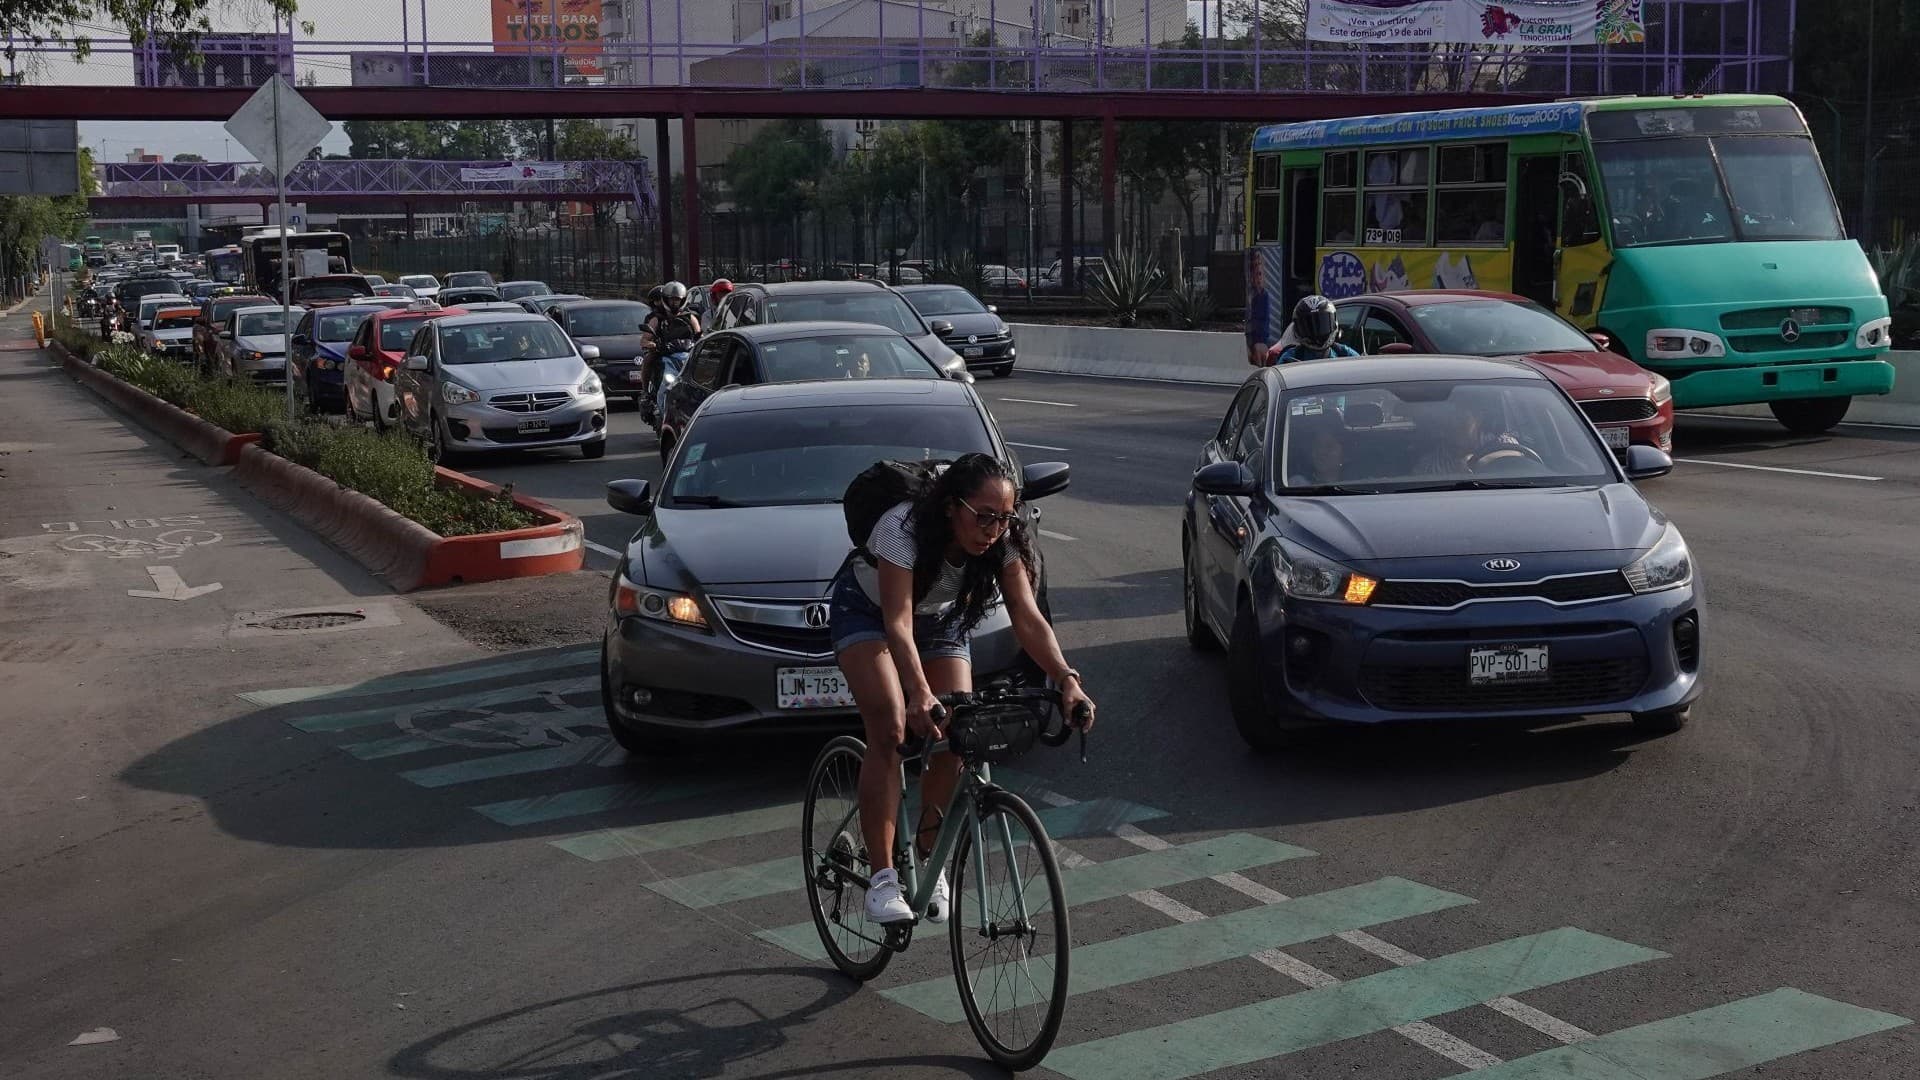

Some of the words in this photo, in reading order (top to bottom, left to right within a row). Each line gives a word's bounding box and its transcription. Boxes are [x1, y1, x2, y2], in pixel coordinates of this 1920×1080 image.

[561, 14, 598, 24] PARA
[506, 24, 600, 41] TODOS
[1329, 27, 1349, 37] Este
[1350, 27, 1388, 39] domingo
[1390, 28, 1400, 37] 19
[1401, 27, 1412, 37] de
[1413, 27, 1432, 37] abril
[1519, 24, 1535, 34] LA
[1538, 24, 1572, 34] GRAN
[1453, 115, 1477, 129] PRICE
[1480, 113, 1508, 127] SHOES
[1507, 108, 1561, 128] KangaROOS
[1322, 255, 1363, 278] Price
[1489, 559, 1516, 569] KIA
[1471, 652, 1548, 674] PVP-601-C
[780, 677, 851, 696] LJN-753-
